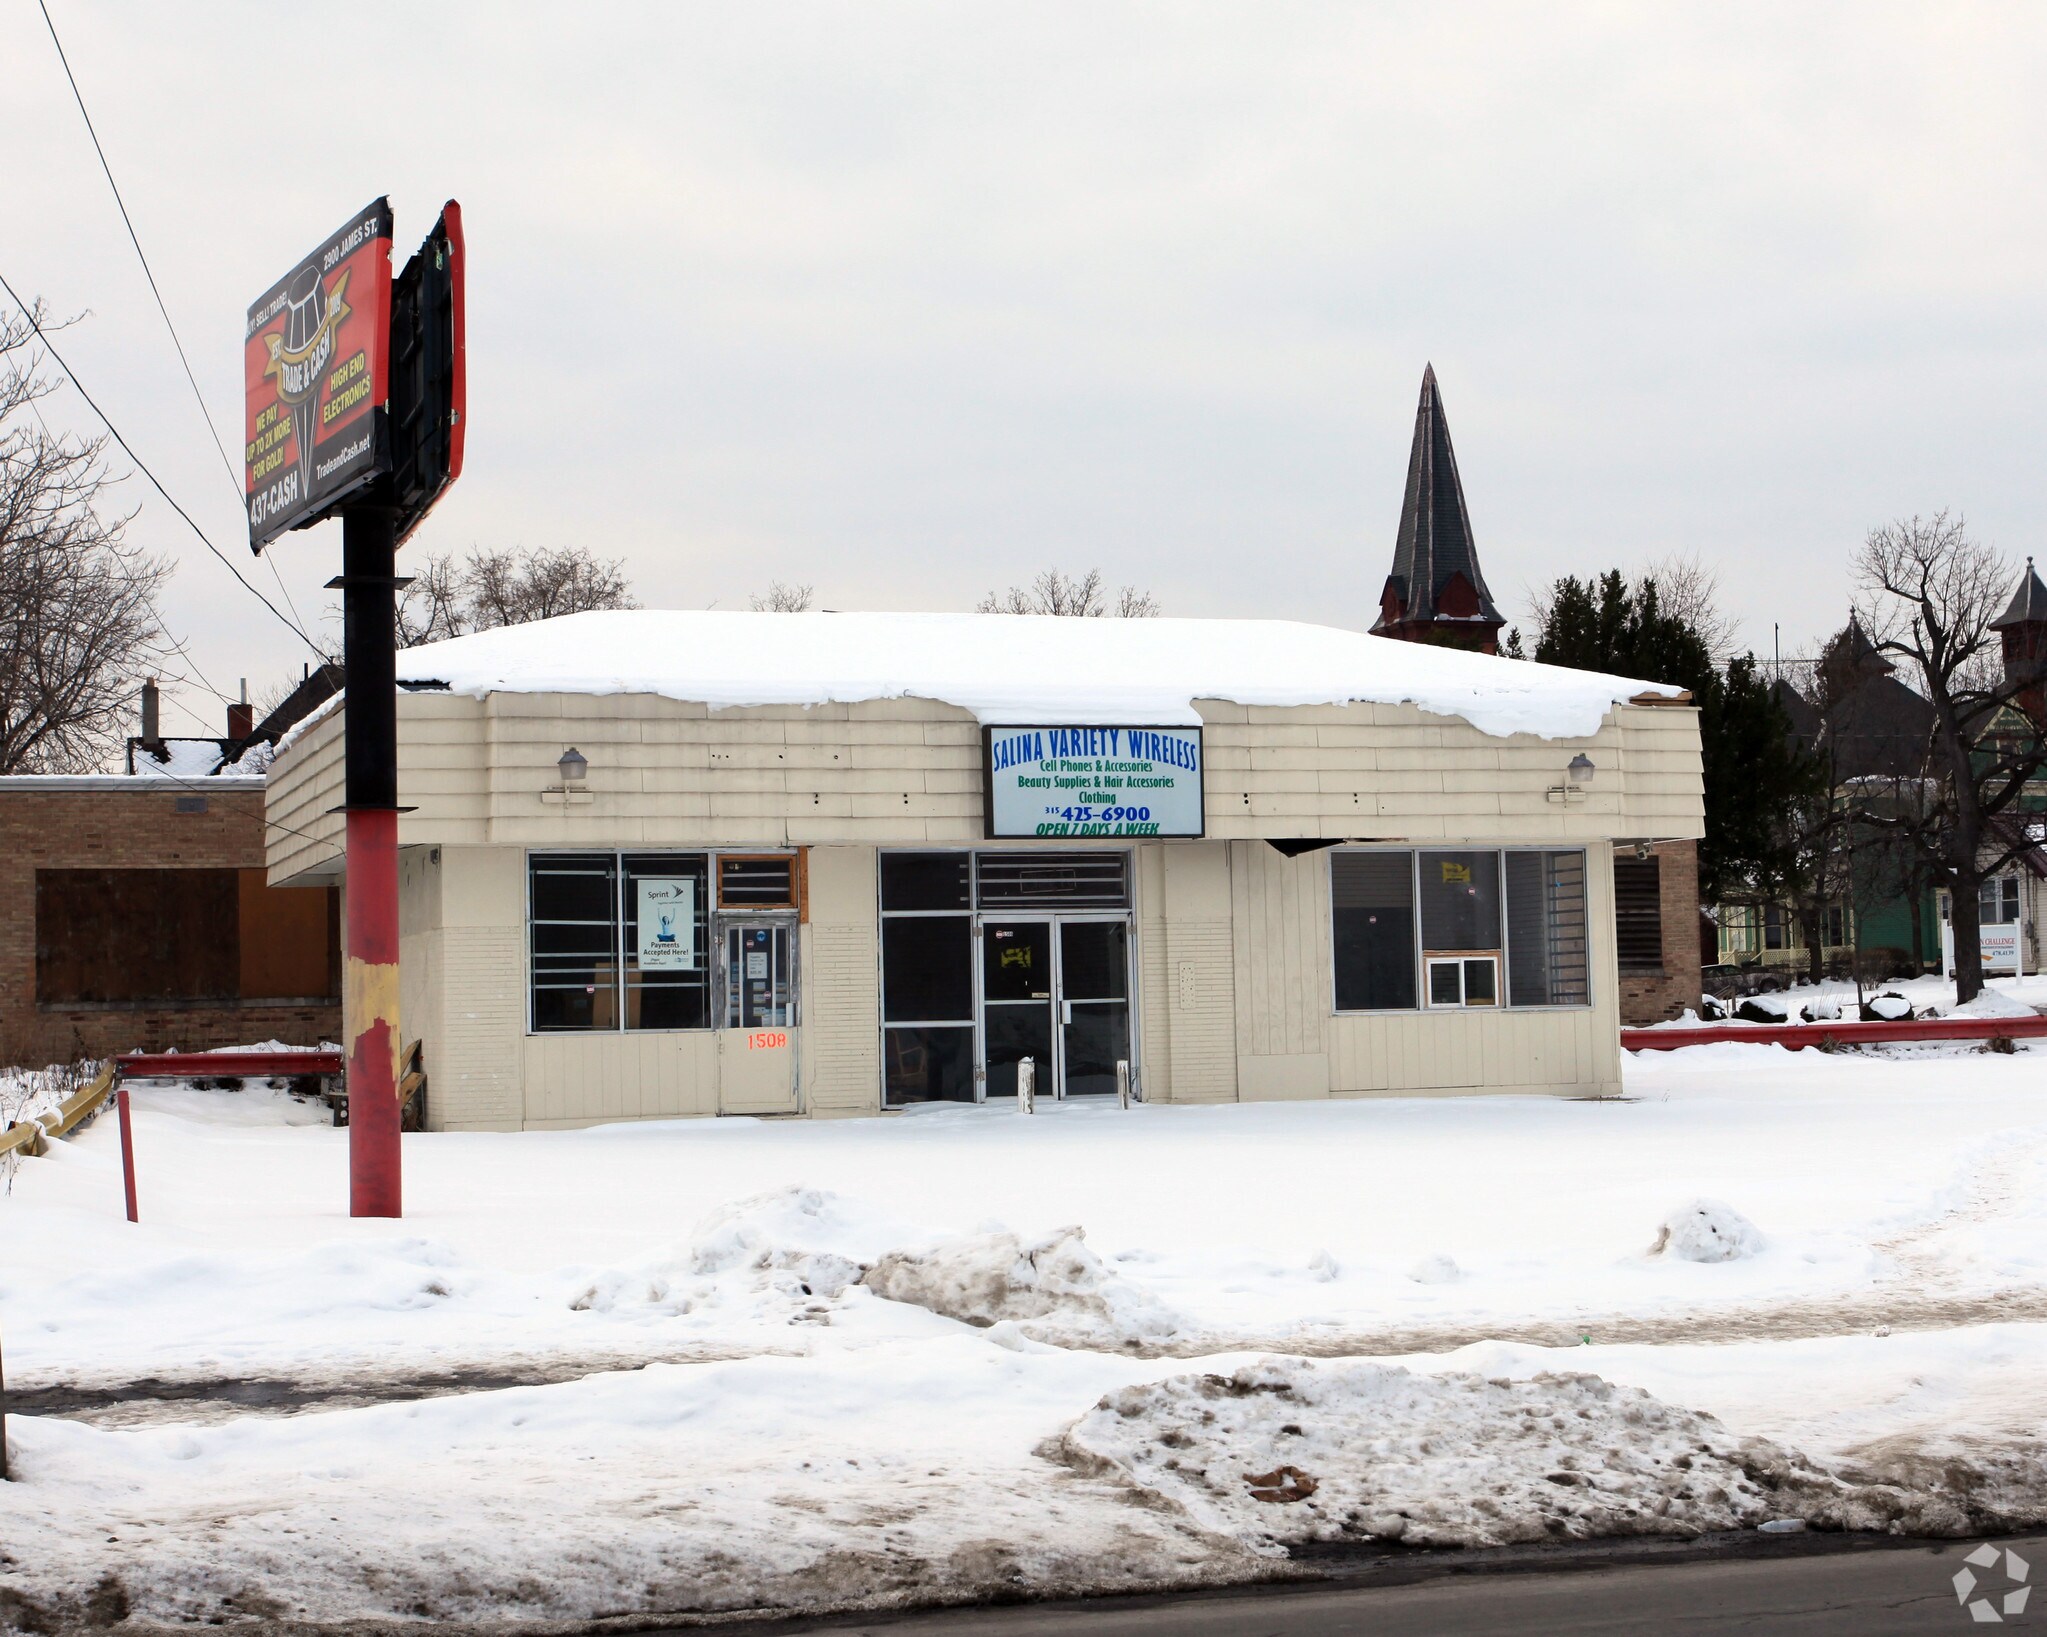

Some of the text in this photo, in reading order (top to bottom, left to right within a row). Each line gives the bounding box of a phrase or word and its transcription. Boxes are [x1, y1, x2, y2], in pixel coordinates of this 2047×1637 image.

[324, 217, 378, 271] 2900 JAMES ST.
[281, 325, 330, 394] TRADE & CASH
[330, 352, 365, 392] HIGH END
[323, 374, 371, 424] ELECTRONICS
[256, 402, 278, 433] WE PAY
[246, 415, 291, 462] UP TO 2X MORE
[253, 445, 284, 482] FOR GOLD!
[316, 433, 370, 481] TradeandCash.net
[250, 470, 298, 527] 437-CASH
[993, 728, 1197, 772] SALINA VARIETY WIRELESS
[1040, 759, 1153, 772] Cell Phones & Accessories
[1018, 775, 1175, 789] Beauty Supplies & Hair Accessories
[1078, 791, 1117, 805] Clothing
[1036, 822, 1161, 836] OPEN 7 DAYS A WEEK
[1045, 806, 1151, 822] 315 425-6900
[647, 890, 670, 900] Sprint
[650, 941, 680, 949] Payments
[748, 1033, 787, 1050] 1508
